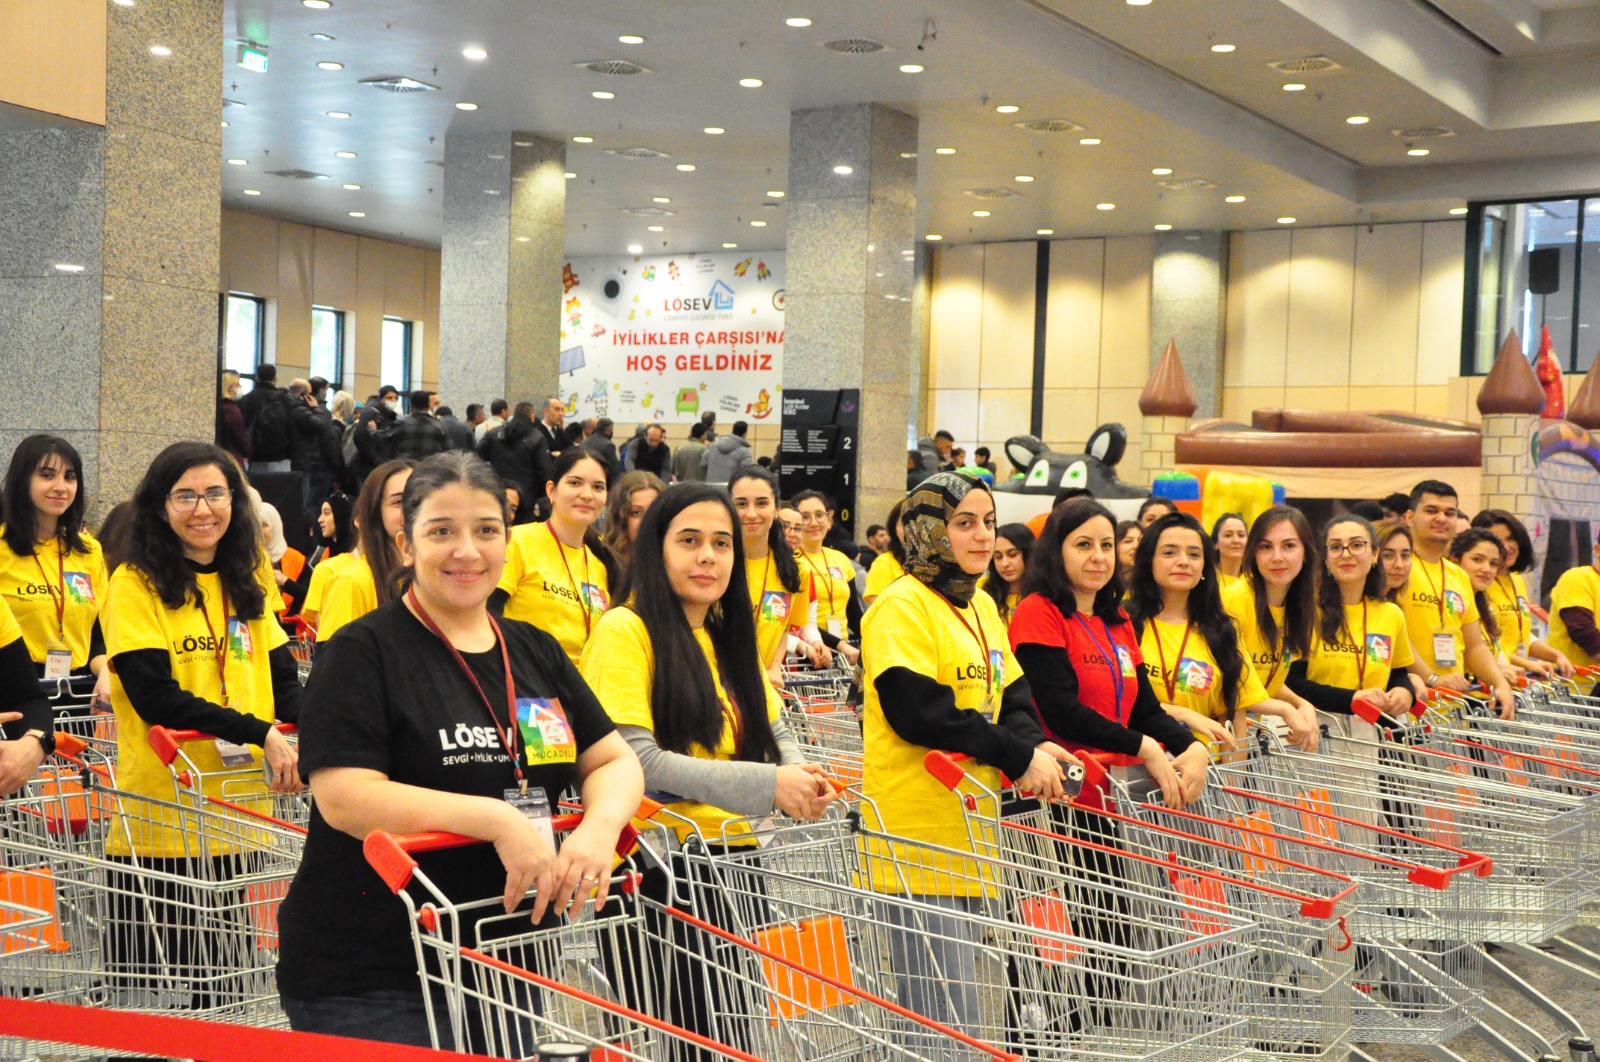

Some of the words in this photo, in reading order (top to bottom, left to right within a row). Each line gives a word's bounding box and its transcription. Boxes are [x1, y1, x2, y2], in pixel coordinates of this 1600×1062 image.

[664, 296, 712, 311] LÖSEV
[613, 330, 689, 346] İYİLİKLER
[626, 355, 667, 376] HOŞ
[675, 350, 773, 371] GELDİNİZ
[843, 436, 852, 450] 2
[843, 473, 849, 486] 1
[841, 508, 849, 521] 0
[1412, 592, 1439, 605] LÖSE
[957, 662, 988, 681] LÖSE
[443, 753, 469, 766] SEVGİ
[498, 753, 520, 762] UMT
